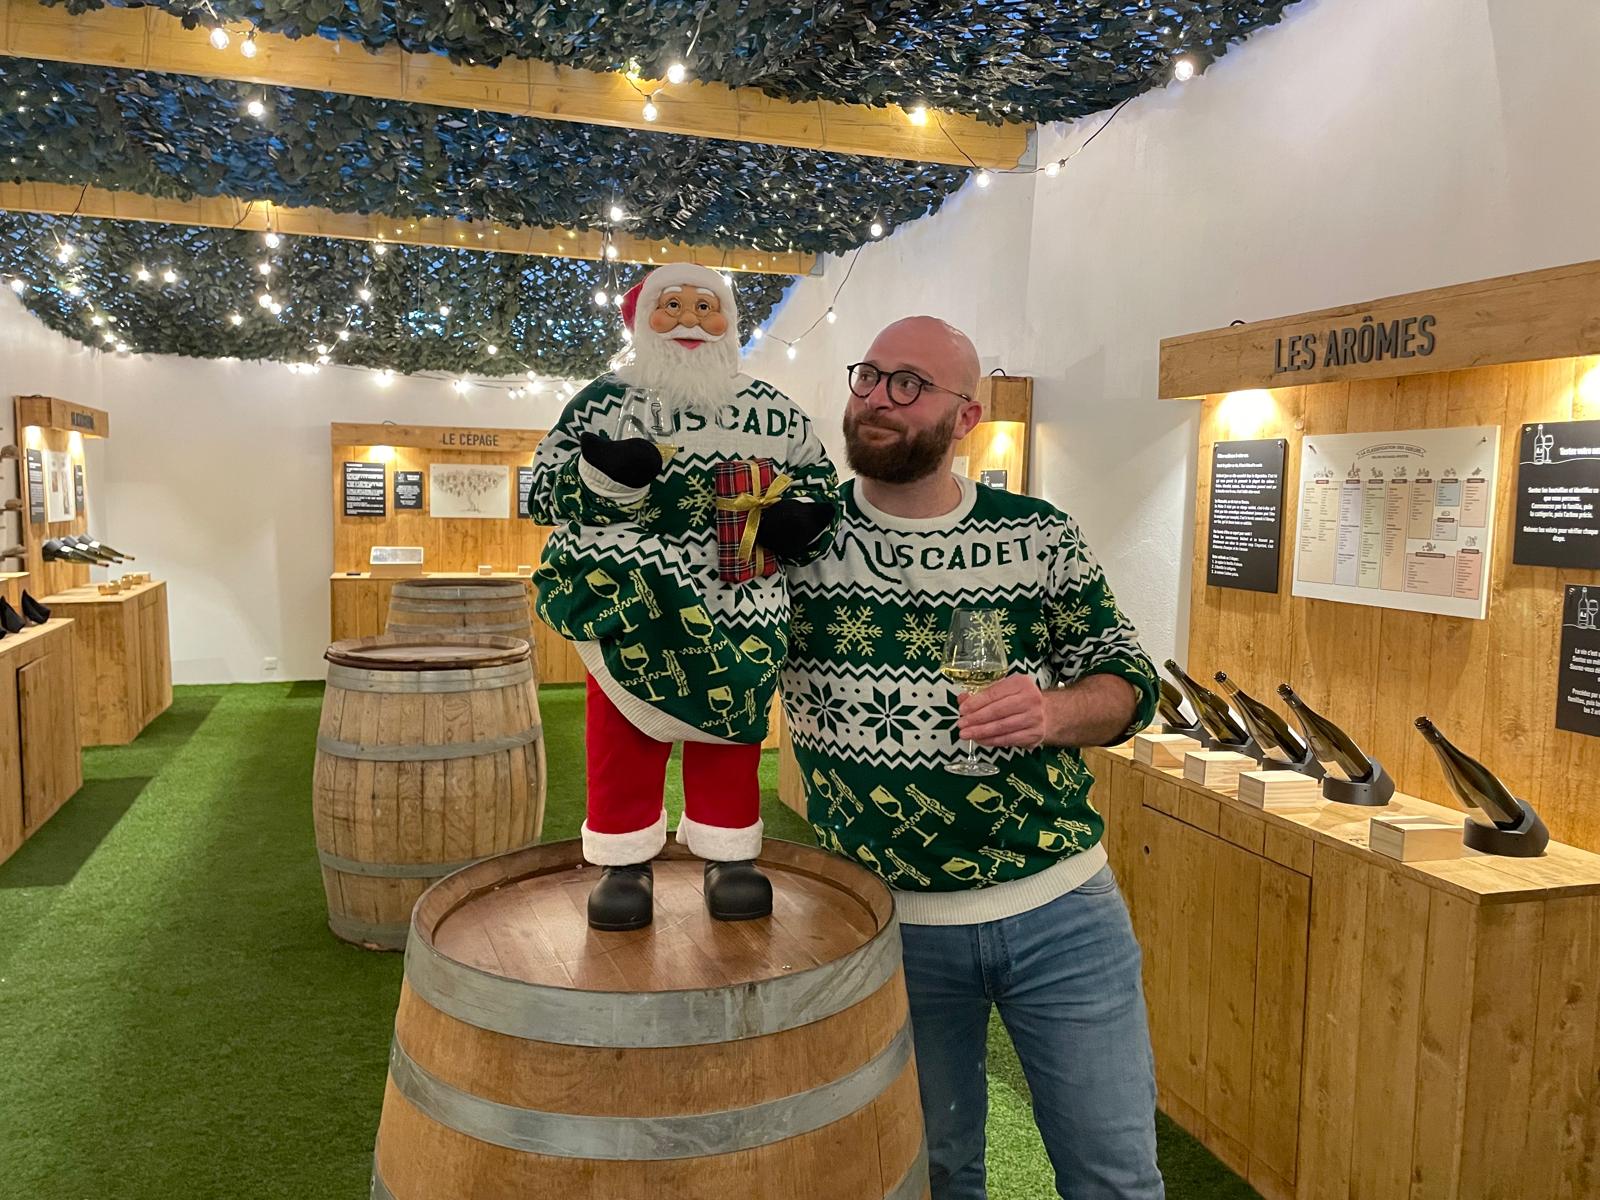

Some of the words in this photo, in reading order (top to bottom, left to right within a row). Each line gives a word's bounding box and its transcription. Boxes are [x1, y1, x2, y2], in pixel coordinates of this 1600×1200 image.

[1274, 333, 1316, 373] LES
[1323, 315, 1436, 367] ARÔMES
[442, 432, 456, 445] LE
